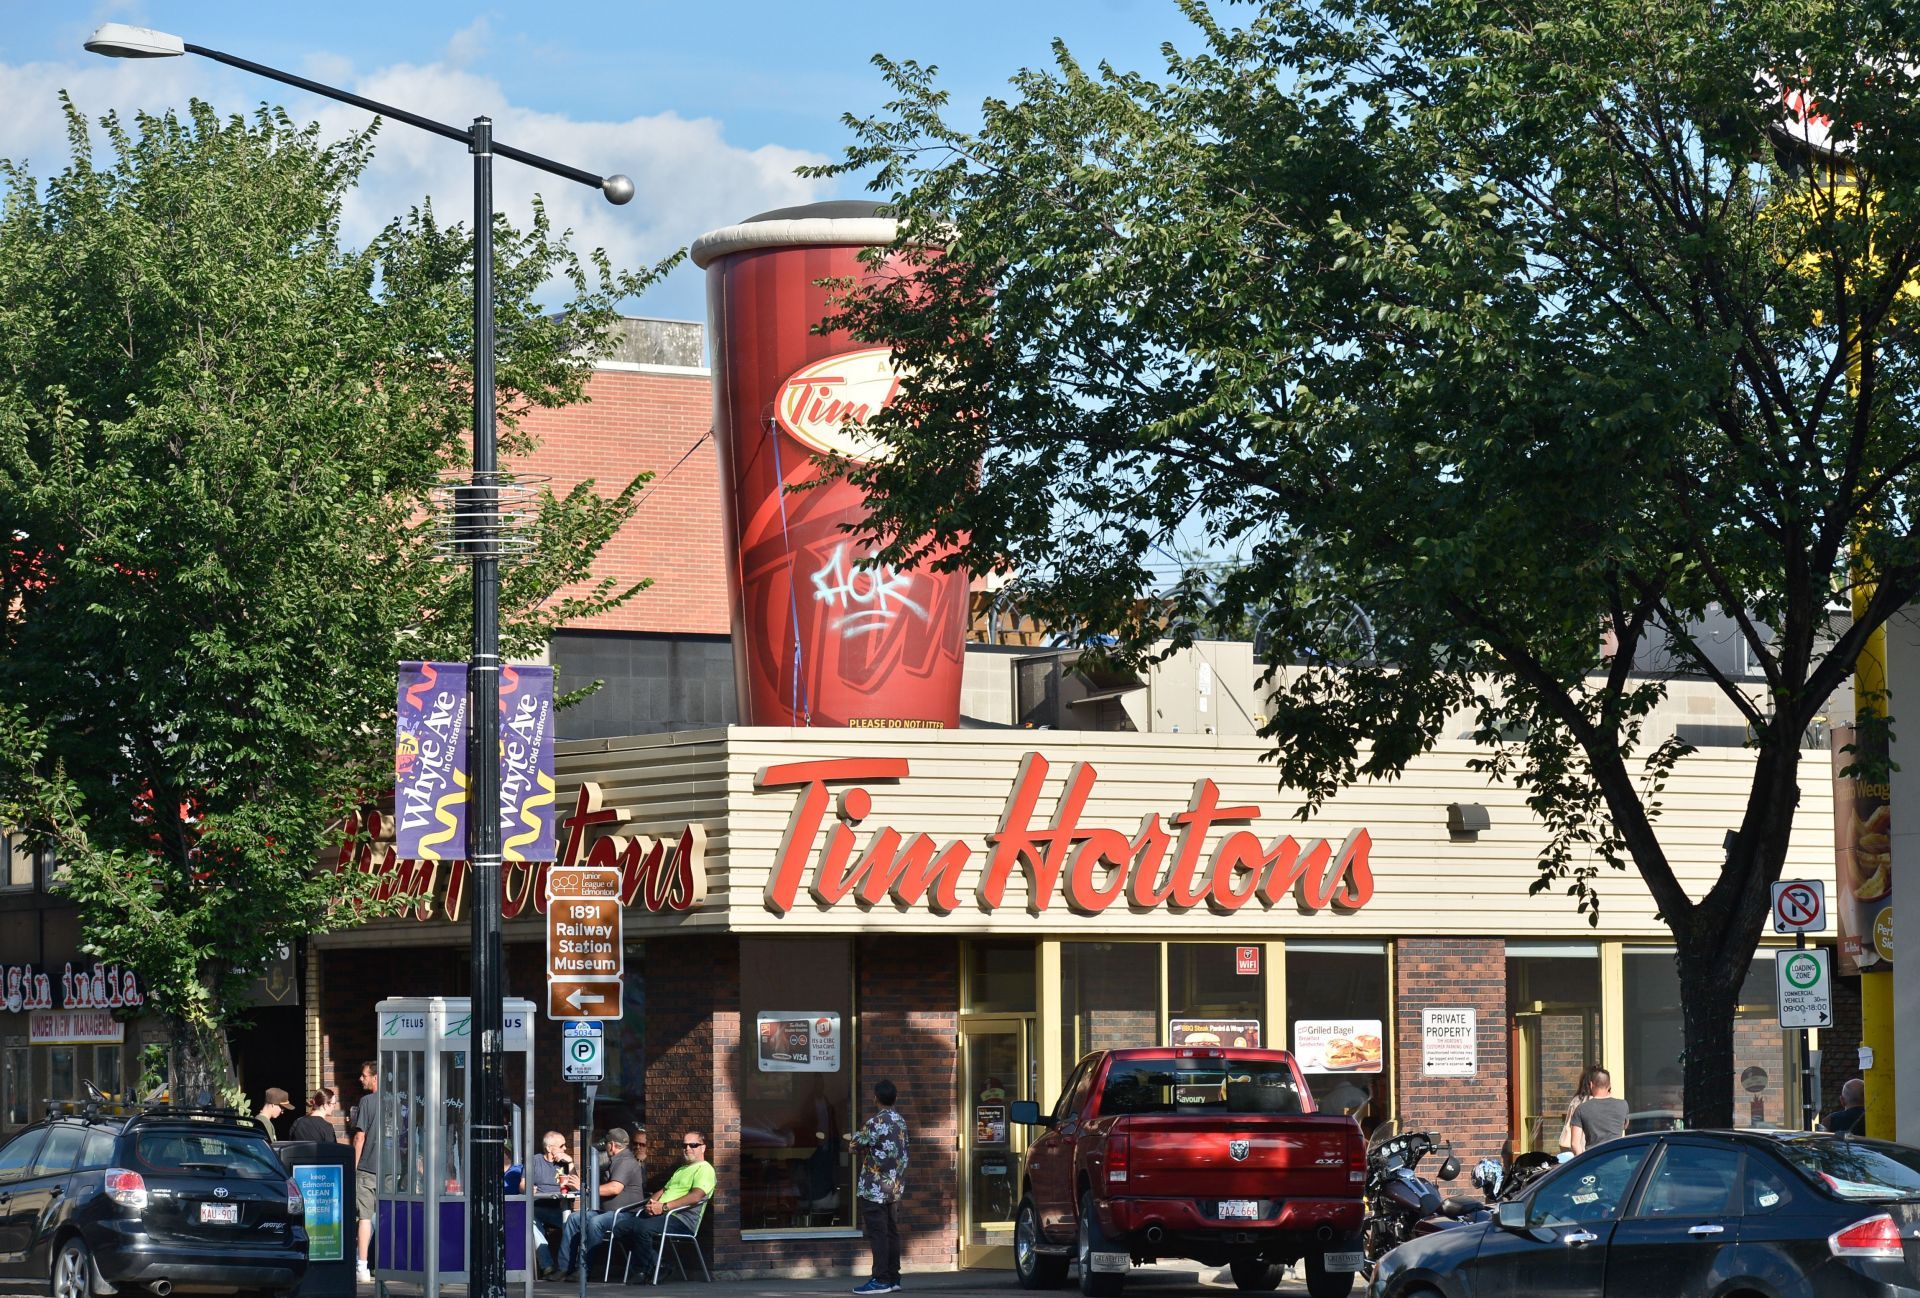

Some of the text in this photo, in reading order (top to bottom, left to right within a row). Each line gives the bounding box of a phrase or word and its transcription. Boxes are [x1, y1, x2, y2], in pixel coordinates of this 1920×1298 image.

[789, 376, 870, 427] Tim
[849, 719, 887, 729] PLEASE
[888, 719, 903, 729] DO
[903, 720, 921, 729] NOT
[441, 697, 467, 773] In Old Strathcona
[527, 700, 549, 775] In Old Strathcona
[400, 691, 457, 832] Whyte Ave
[500, 693, 538, 829] Whyte Ave
[753, 751, 1375, 915] Tim Hortons
[582, 872, 601, 880] Junior
[582, 880, 605, 890] League
[582, 888, 615, 896] Edmonton
[569, 905, 600, 919] 1891
[556, 922, 613, 941] Railway
[558, 939, 612, 953] Station
[554, 957, 616, 970] Museum
[1791, 964, 1815, 972] LOADING
[1795, 971, 1811, 979] ZONE
[402, 1018, 424, 1028] TELUS
[1431, 1013, 1467, 1024] PRIVATE
[32, 1015, 54, 1037] UNDER
[55, 1015, 70, 1037] NEW
[1308, 1025, 1331, 1034] Grilled
[1333, 1026, 1354, 1036] Bagel
[1426, 1027, 1472, 1037] PROPERTY
[792, 1053, 808, 1062] VISA
[1176, 1095, 1206, 1104] Savoury
[310, 1173, 327, 1182] keep
[1219, 1206, 1257, 1216] ZAZ-666
